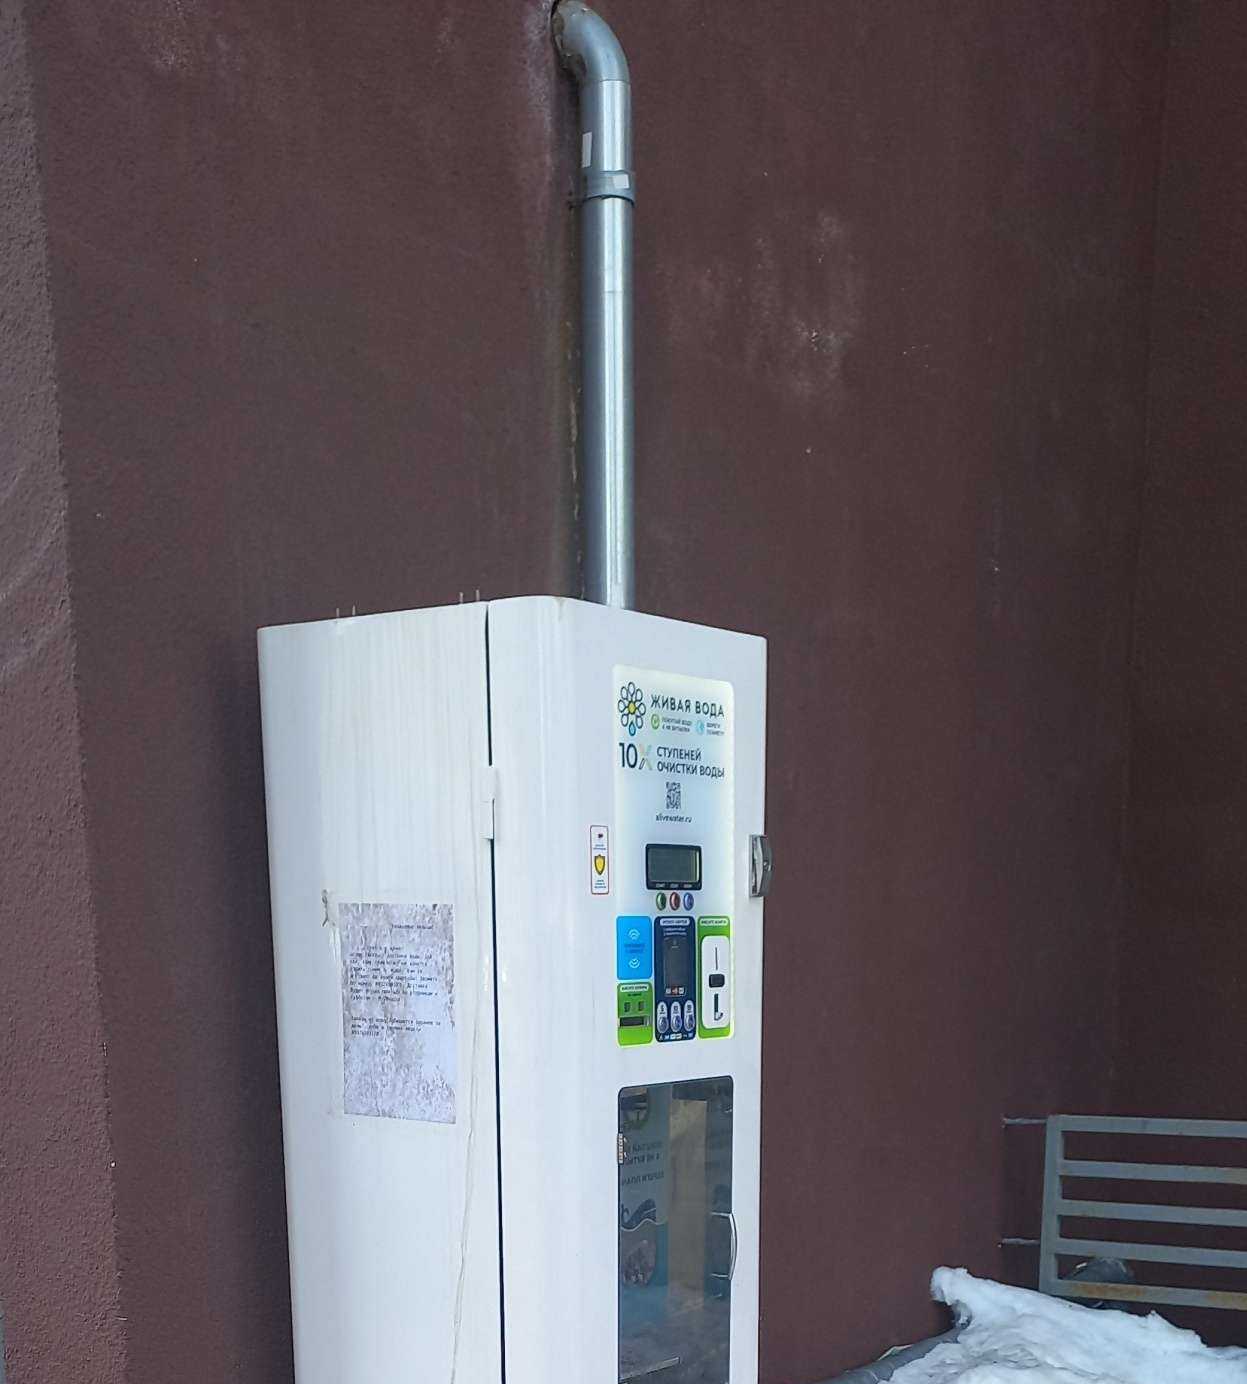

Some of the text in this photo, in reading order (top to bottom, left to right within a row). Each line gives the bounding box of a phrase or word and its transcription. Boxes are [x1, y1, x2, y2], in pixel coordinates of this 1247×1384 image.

[651, 694, 725, 719] ЖИВАЯ ВОДА
[618, 742, 638, 769] 10
[656, 746, 702, 761] СТУПЕНЕЙ
[656, 761, 725, 779] ОЧИСТКИ ВОДЫ
